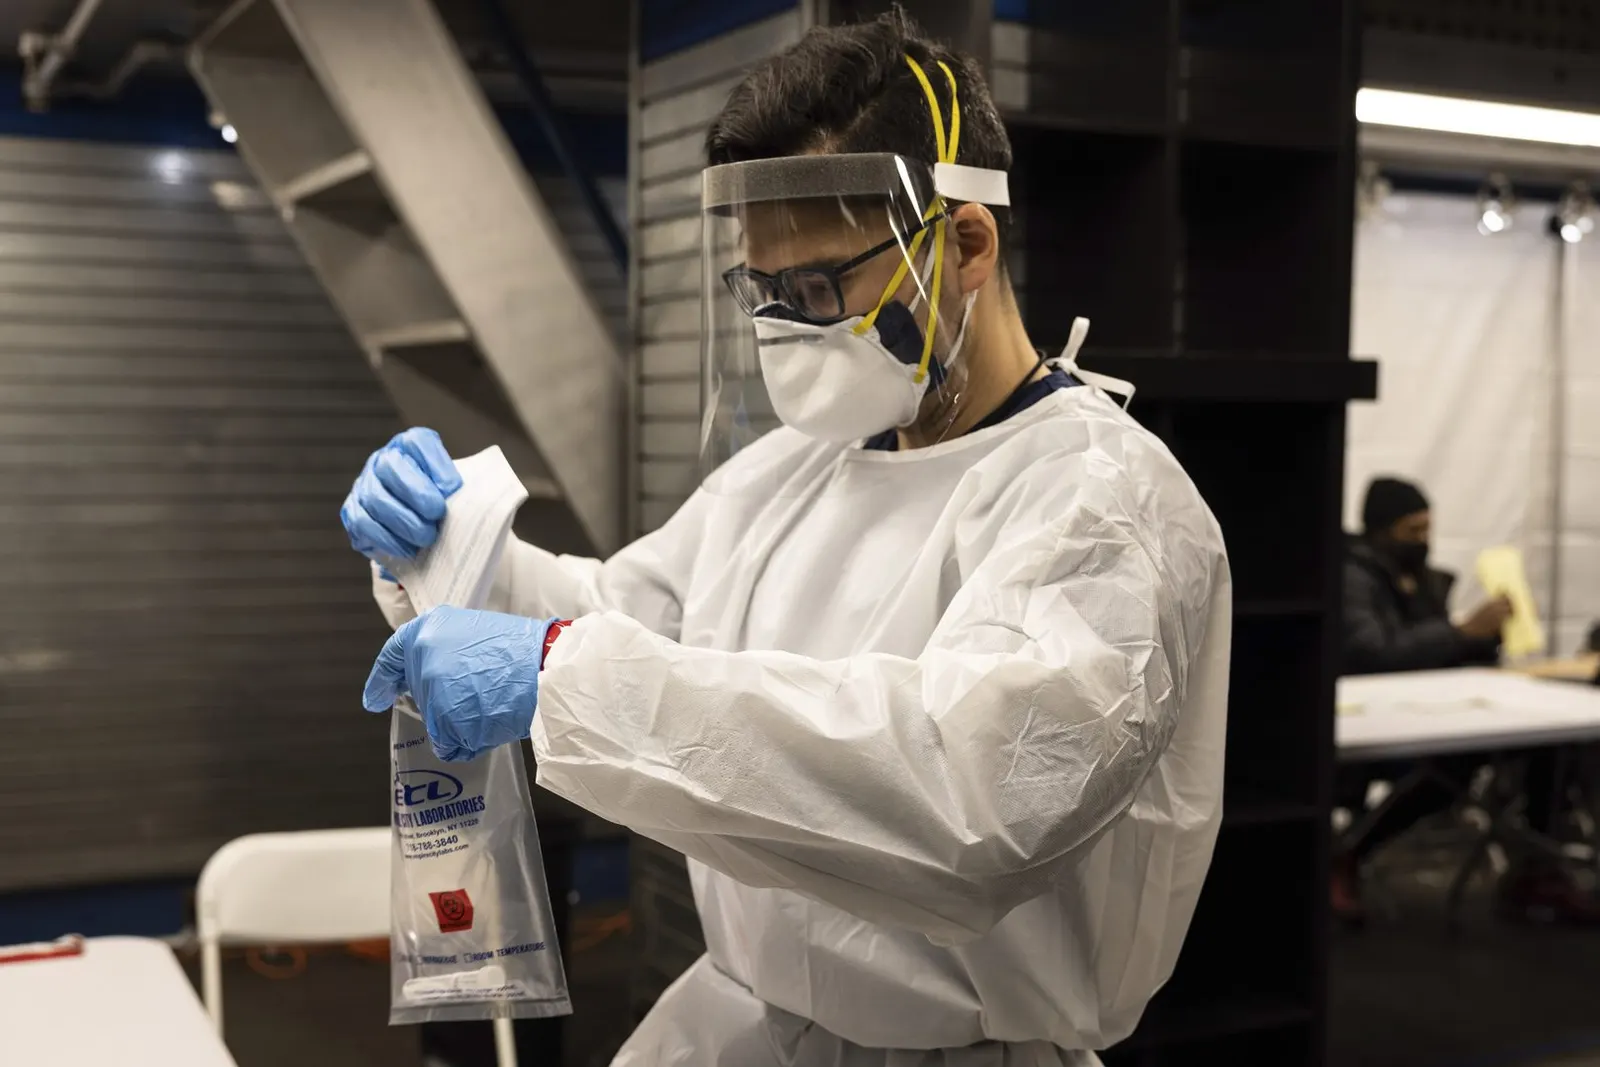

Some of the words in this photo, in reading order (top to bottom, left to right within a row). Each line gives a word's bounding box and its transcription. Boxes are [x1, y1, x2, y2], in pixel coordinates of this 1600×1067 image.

[406, 736, 425, 748] ONLY
[413, 795, 485, 827] LABORATORIES
[415, 827, 447, 839] Brooklyn,
[447, 823, 458, 832] NY
[472, 951, 494, 962] ROOM
[496, 941, 546, 957] TEMPERATURE
